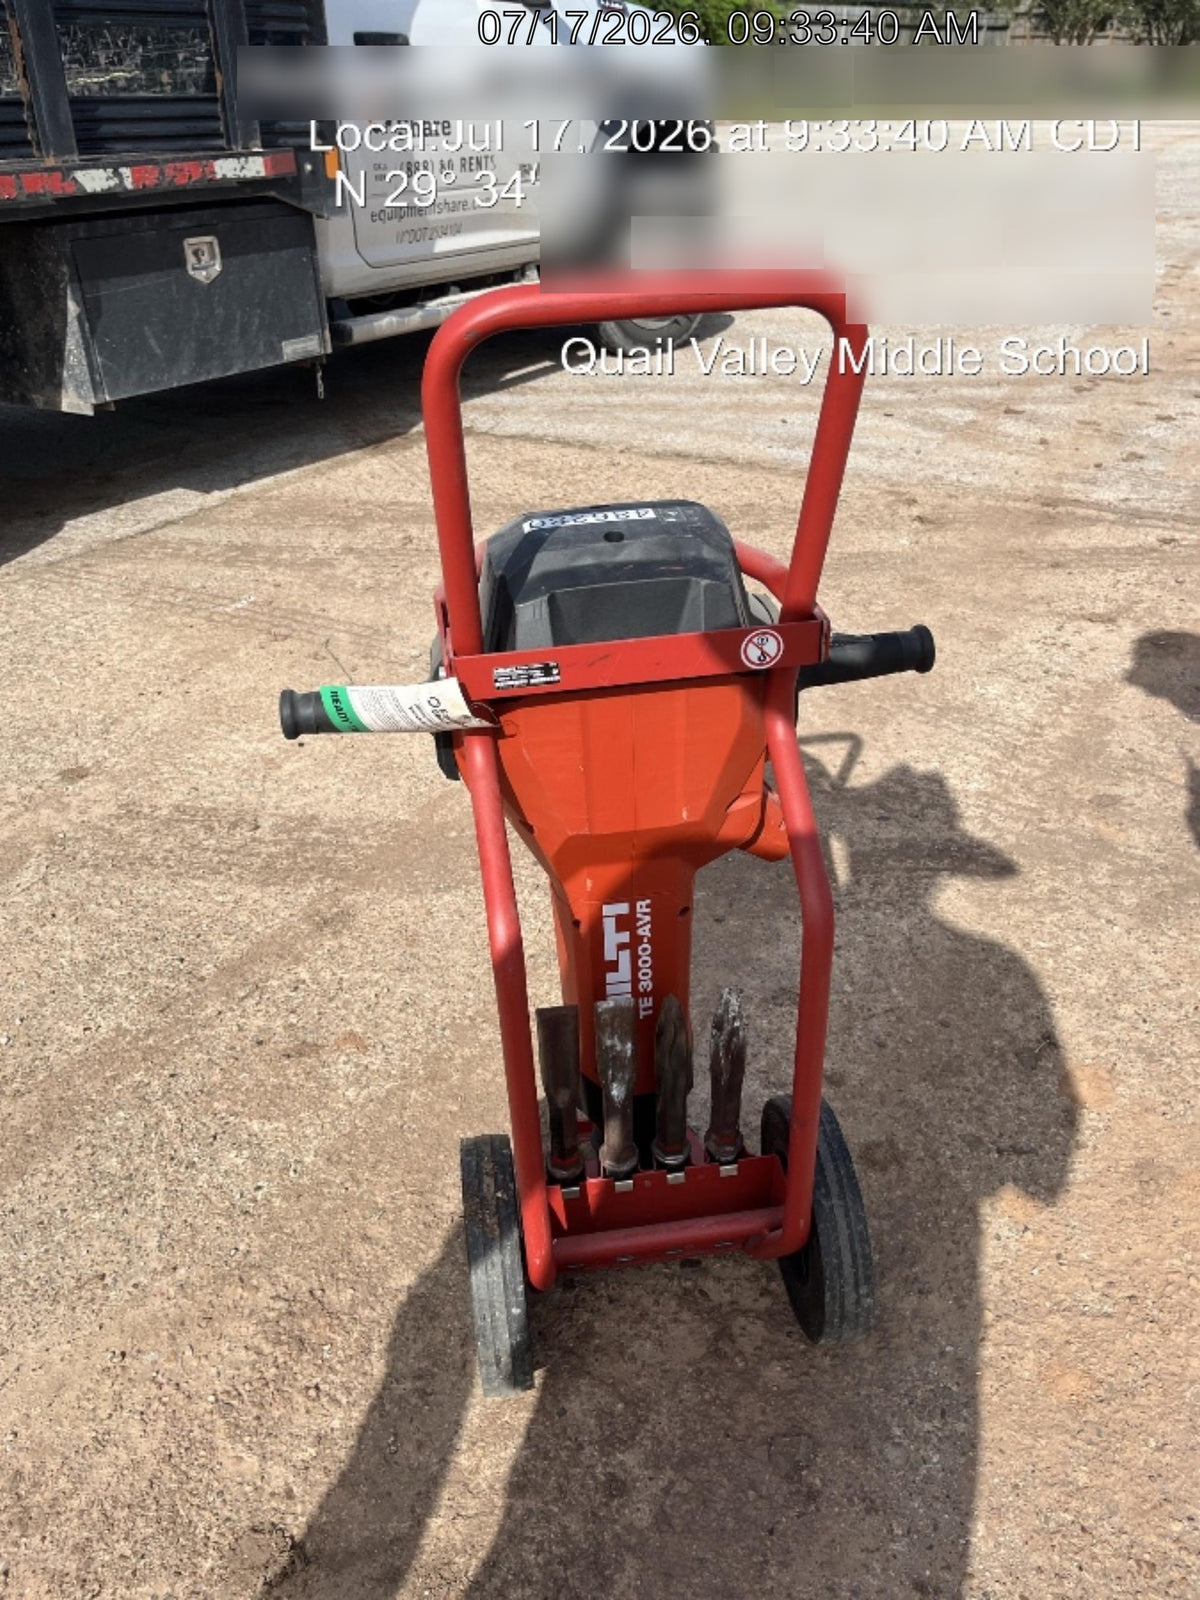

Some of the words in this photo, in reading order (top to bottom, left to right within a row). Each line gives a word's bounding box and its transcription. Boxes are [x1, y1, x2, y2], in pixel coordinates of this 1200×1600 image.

[460, 154, 497, 173] RENTS
[636, 899, 653, 993] 3000-AVR
[639, 996, 653, 1020] TE
